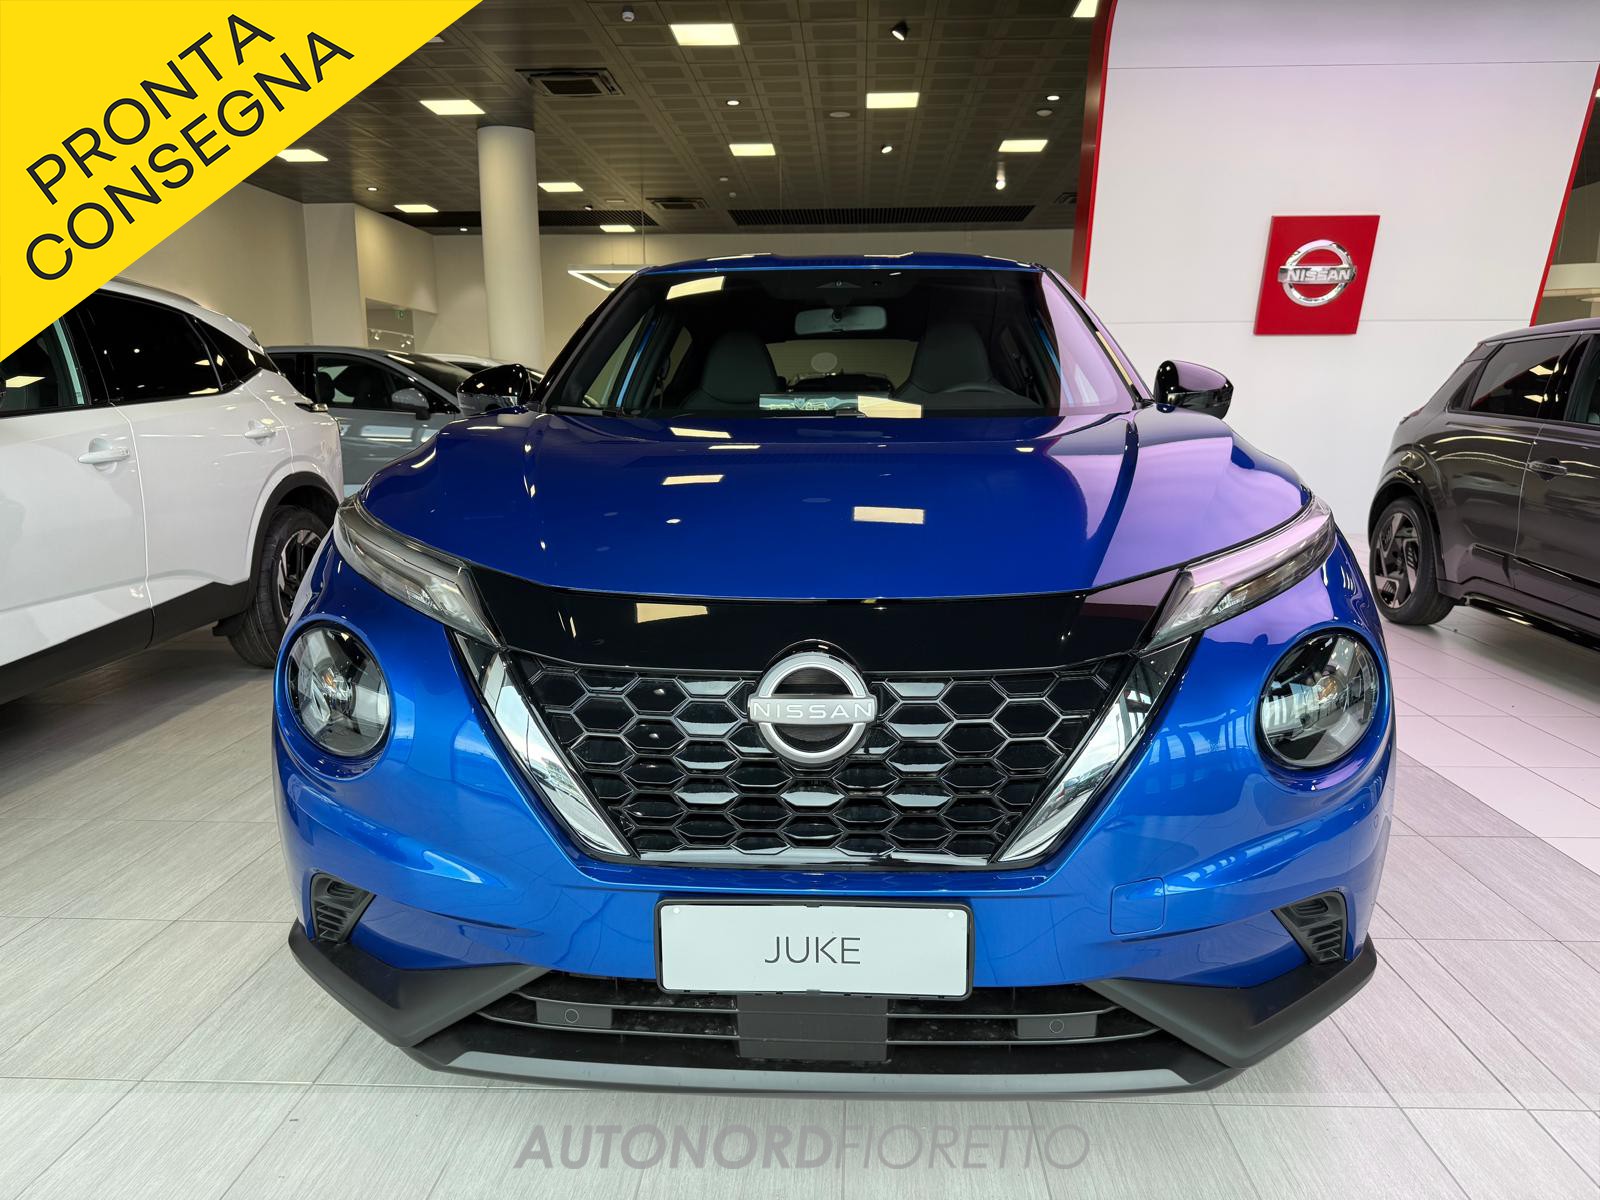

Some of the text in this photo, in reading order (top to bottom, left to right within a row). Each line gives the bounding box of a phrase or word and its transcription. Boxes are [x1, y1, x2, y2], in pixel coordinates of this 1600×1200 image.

[1286, 269, 1351, 281] NISSAN
[753, 703, 873, 719] NISSAN
[764, 936, 861, 965] JUKE
